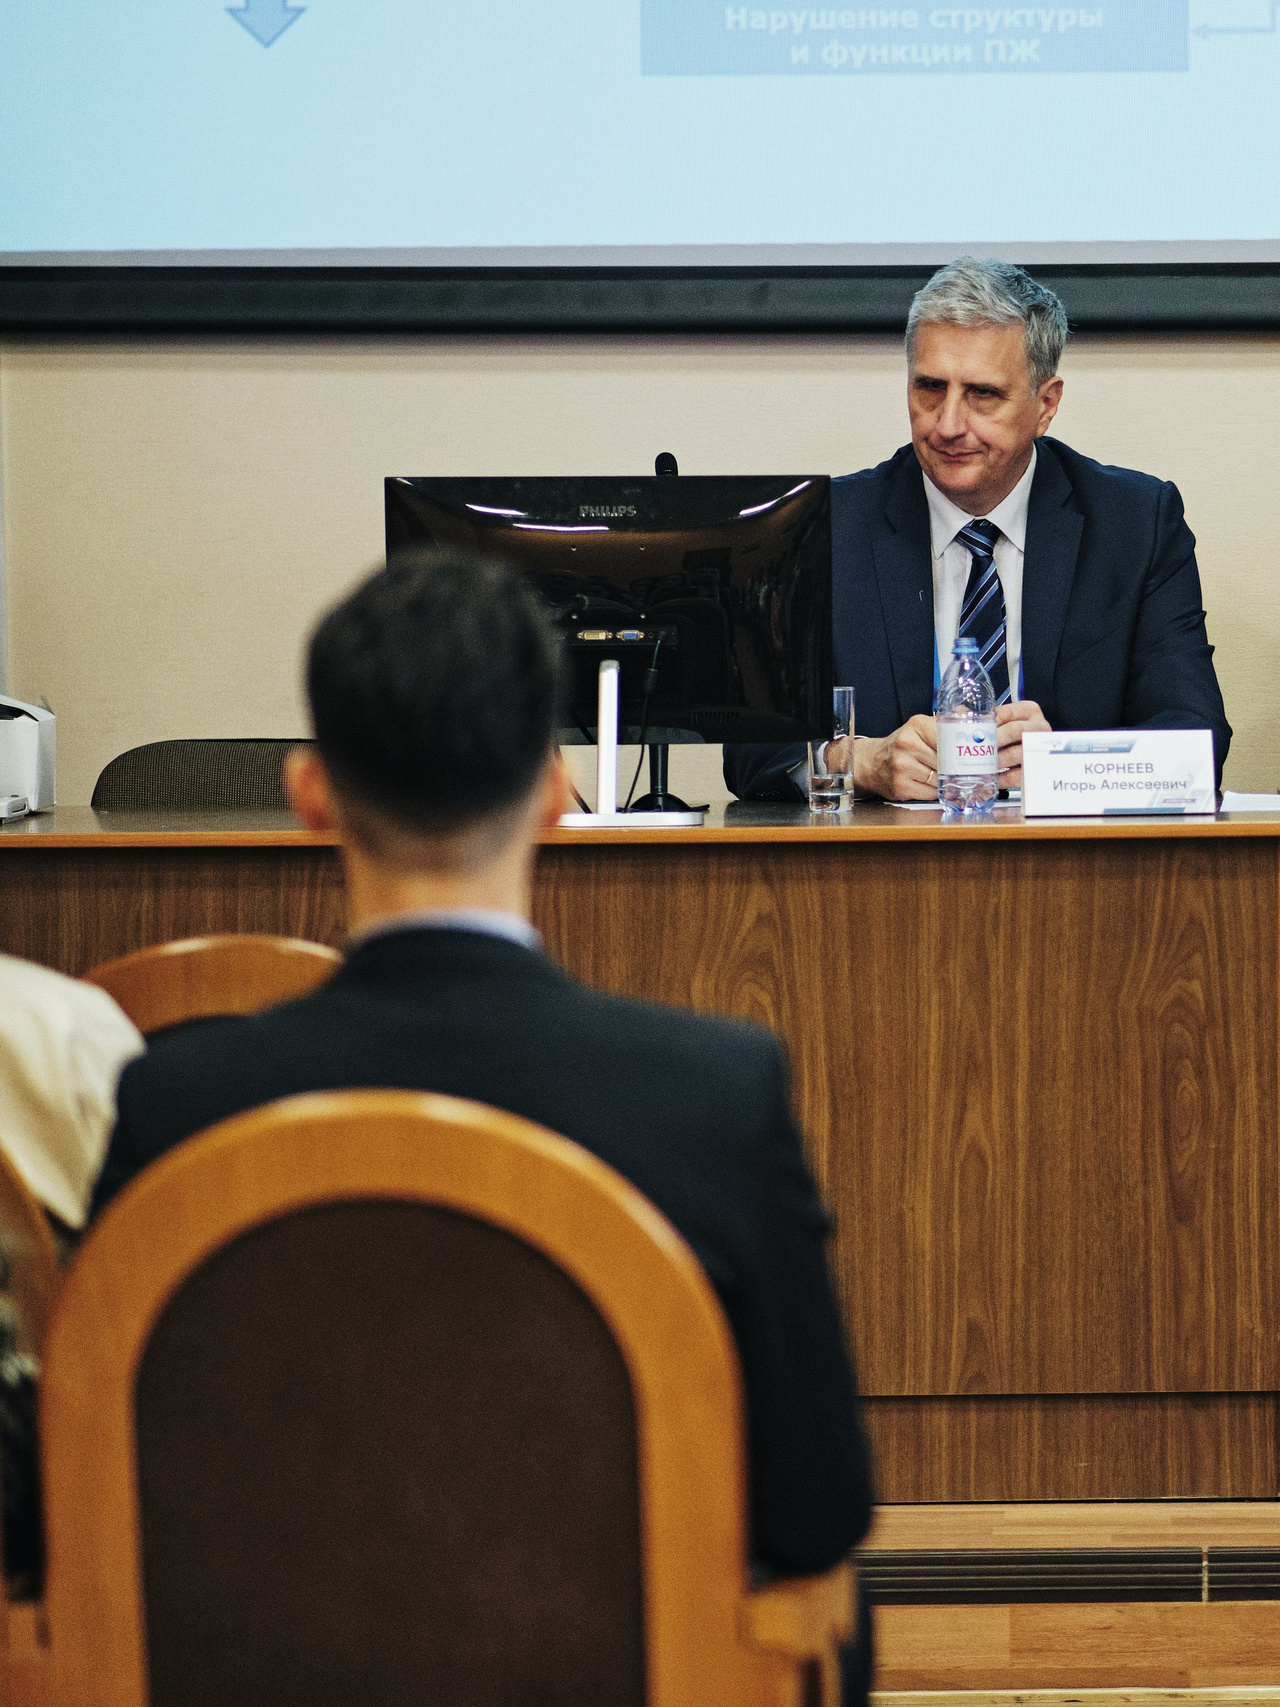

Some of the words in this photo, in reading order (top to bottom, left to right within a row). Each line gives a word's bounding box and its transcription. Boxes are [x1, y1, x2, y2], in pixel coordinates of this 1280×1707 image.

[724, 5, 920, 35] Нарушение
[929, 6, 1104, 34] структуры
[789, 43, 811, 65] и
[820, 37, 974, 69] функции
[983, 37, 1042, 64] ПЖ
[579, 505, 637, 518] PHILIPS
[955, 744, 996, 757] TASSAY
[1084, 762, 1155, 775] КОРНЕЕВ
[1052, 780, 1097, 793] Игорь
[1100, 779, 1188, 790] Алексеевич
